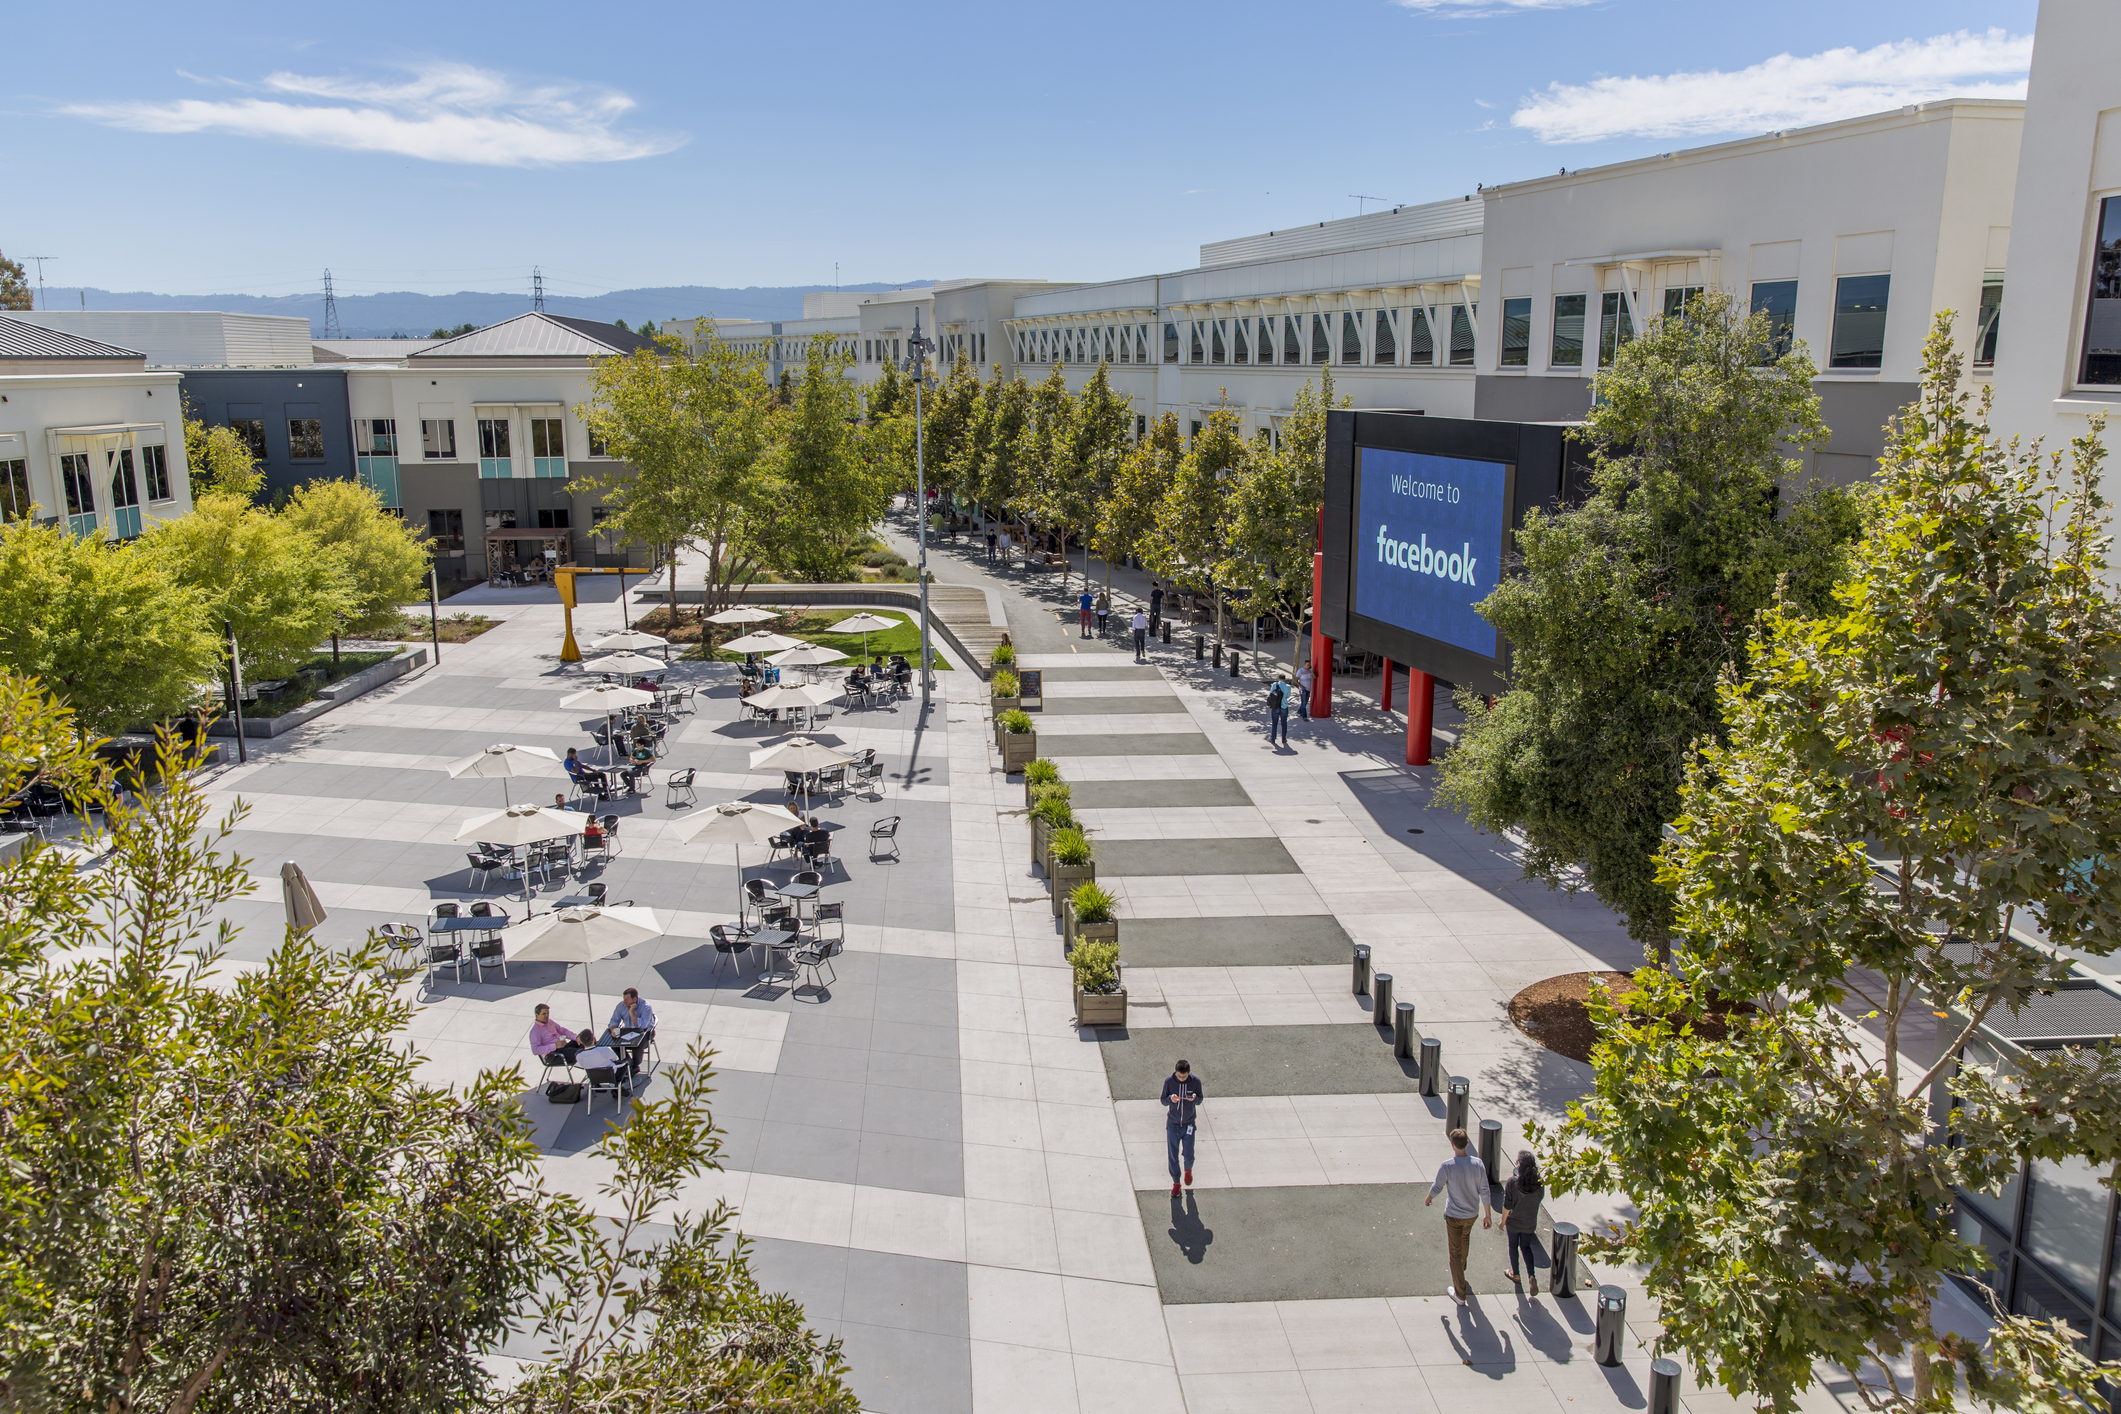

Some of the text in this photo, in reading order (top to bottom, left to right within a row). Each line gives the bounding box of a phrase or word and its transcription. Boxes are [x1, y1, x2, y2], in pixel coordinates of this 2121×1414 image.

[1391, 474, 1460, 504] Welcome to
[1376, 524, 1477, 586] facebook
